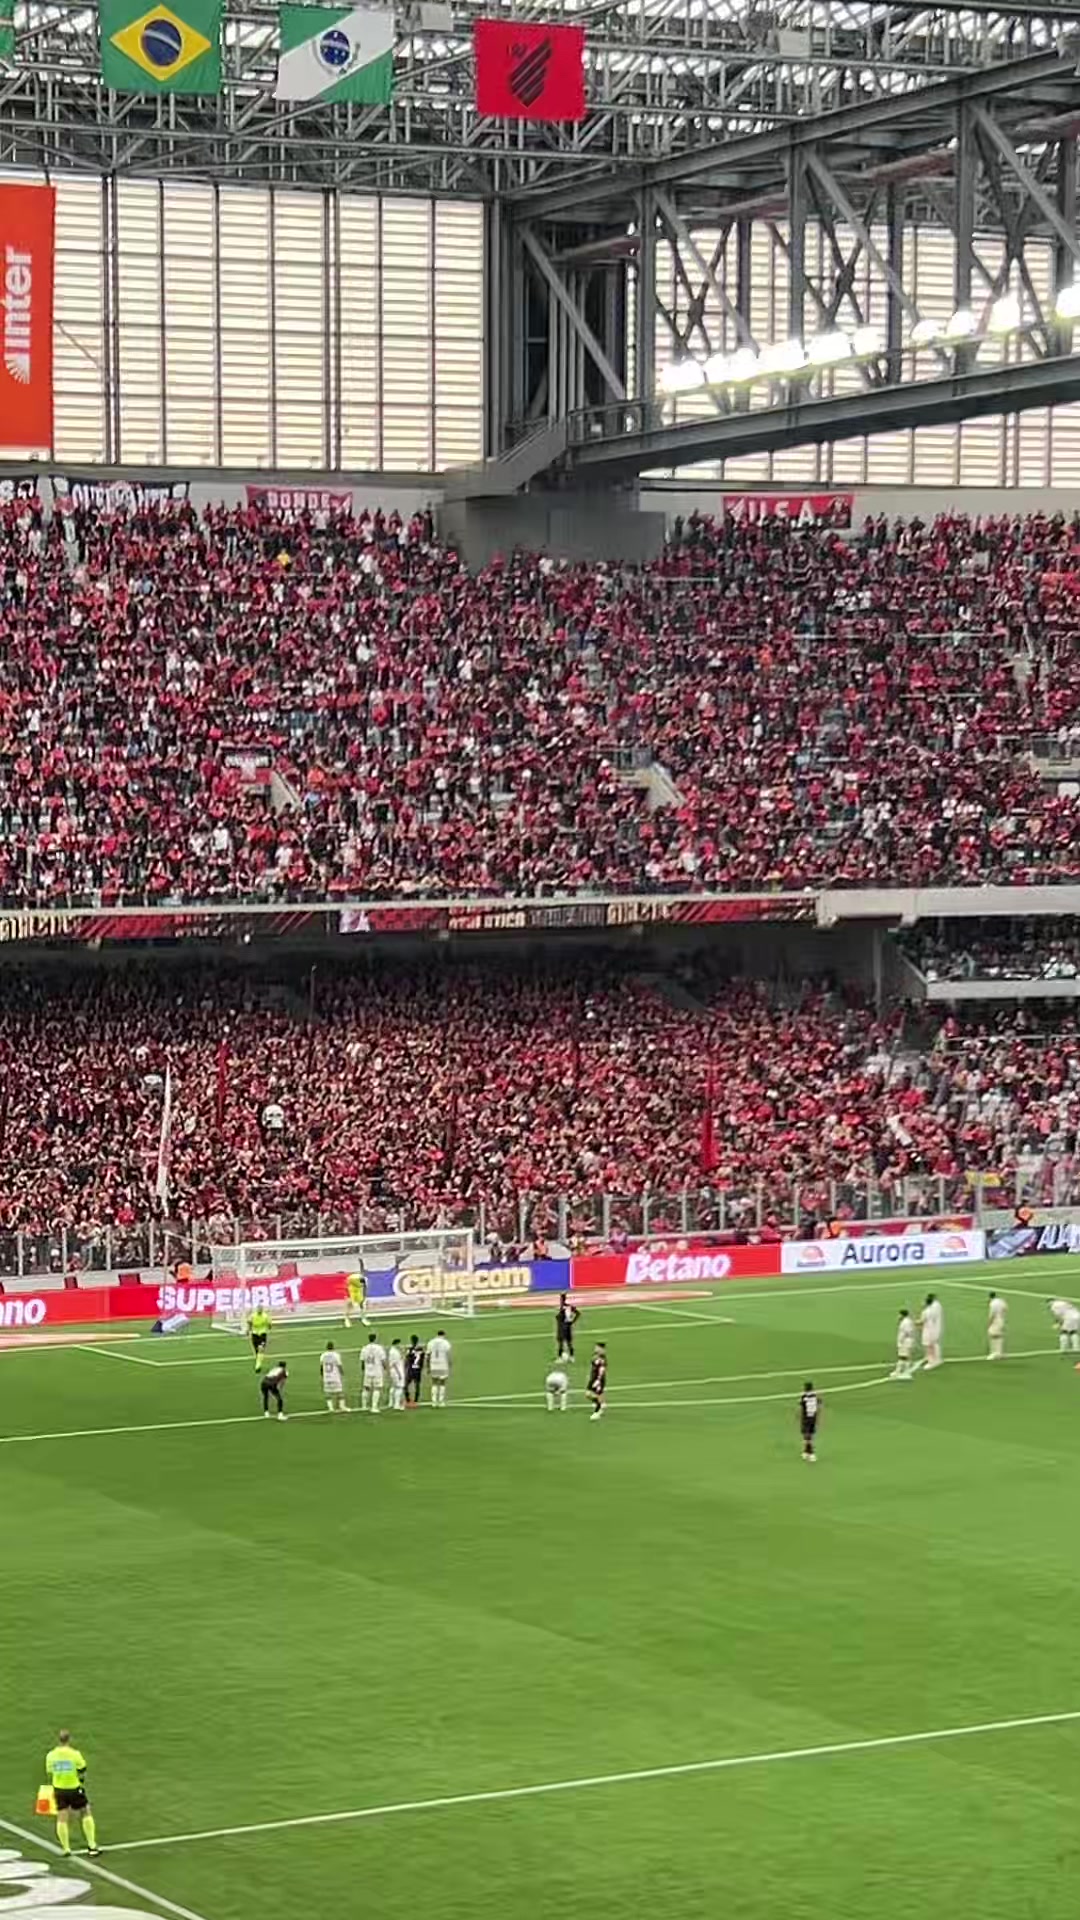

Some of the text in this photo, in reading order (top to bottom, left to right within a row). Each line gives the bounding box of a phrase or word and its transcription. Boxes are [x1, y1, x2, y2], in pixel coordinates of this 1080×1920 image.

[5, 244, 32, 347] inter
[625, 1252, 731, 1283] Betano
[840, 1242, 925, 1265] Aurora
[157, 1279, 303, 1313] SUPERBET
